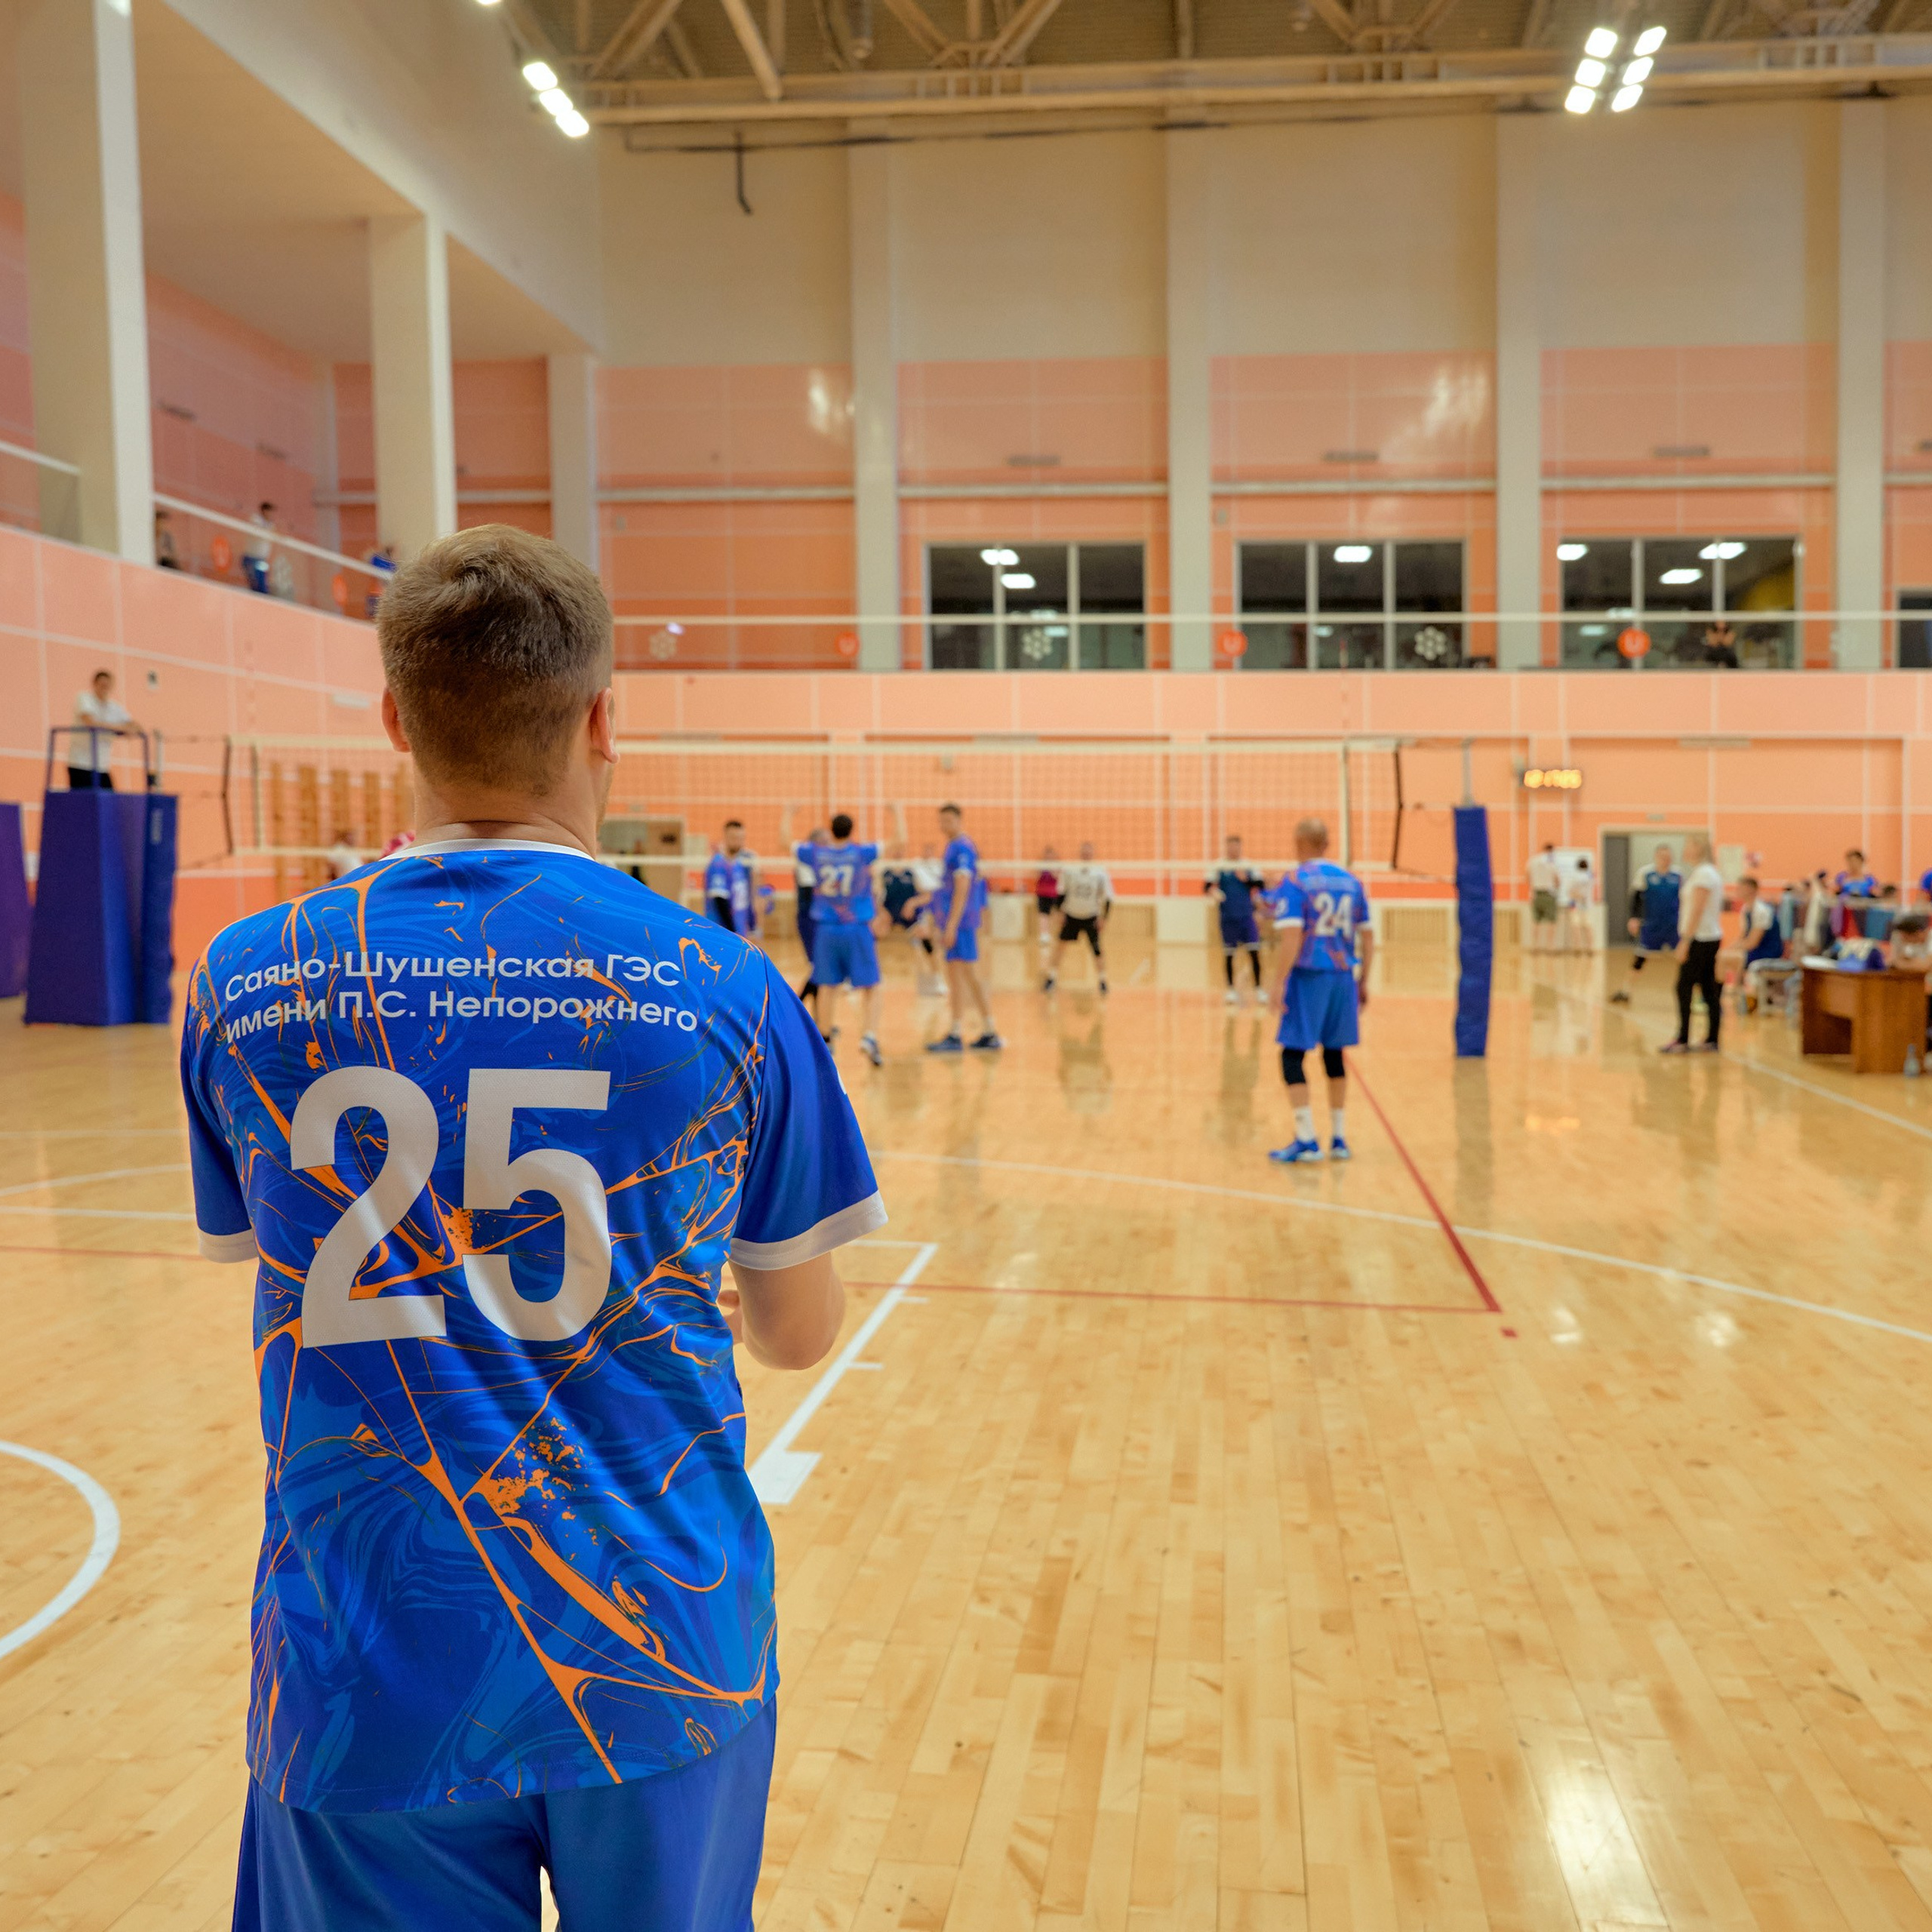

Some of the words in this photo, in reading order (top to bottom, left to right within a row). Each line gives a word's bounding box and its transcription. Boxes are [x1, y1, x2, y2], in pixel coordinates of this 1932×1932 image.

[819, 864, 854, 897] 27
[1315, 891, 1352, 937] 24
[226, 951, 595, 1002] Саяно-Шушенская
[606, 954, 681, 987] ГЭС
[226, 996, 327, 1044] имени
[339, 992, 415, 1019] П.С.
[429, 991, 698, 1032] Непорожнего
[290, 1066, 612, 1349] 25
